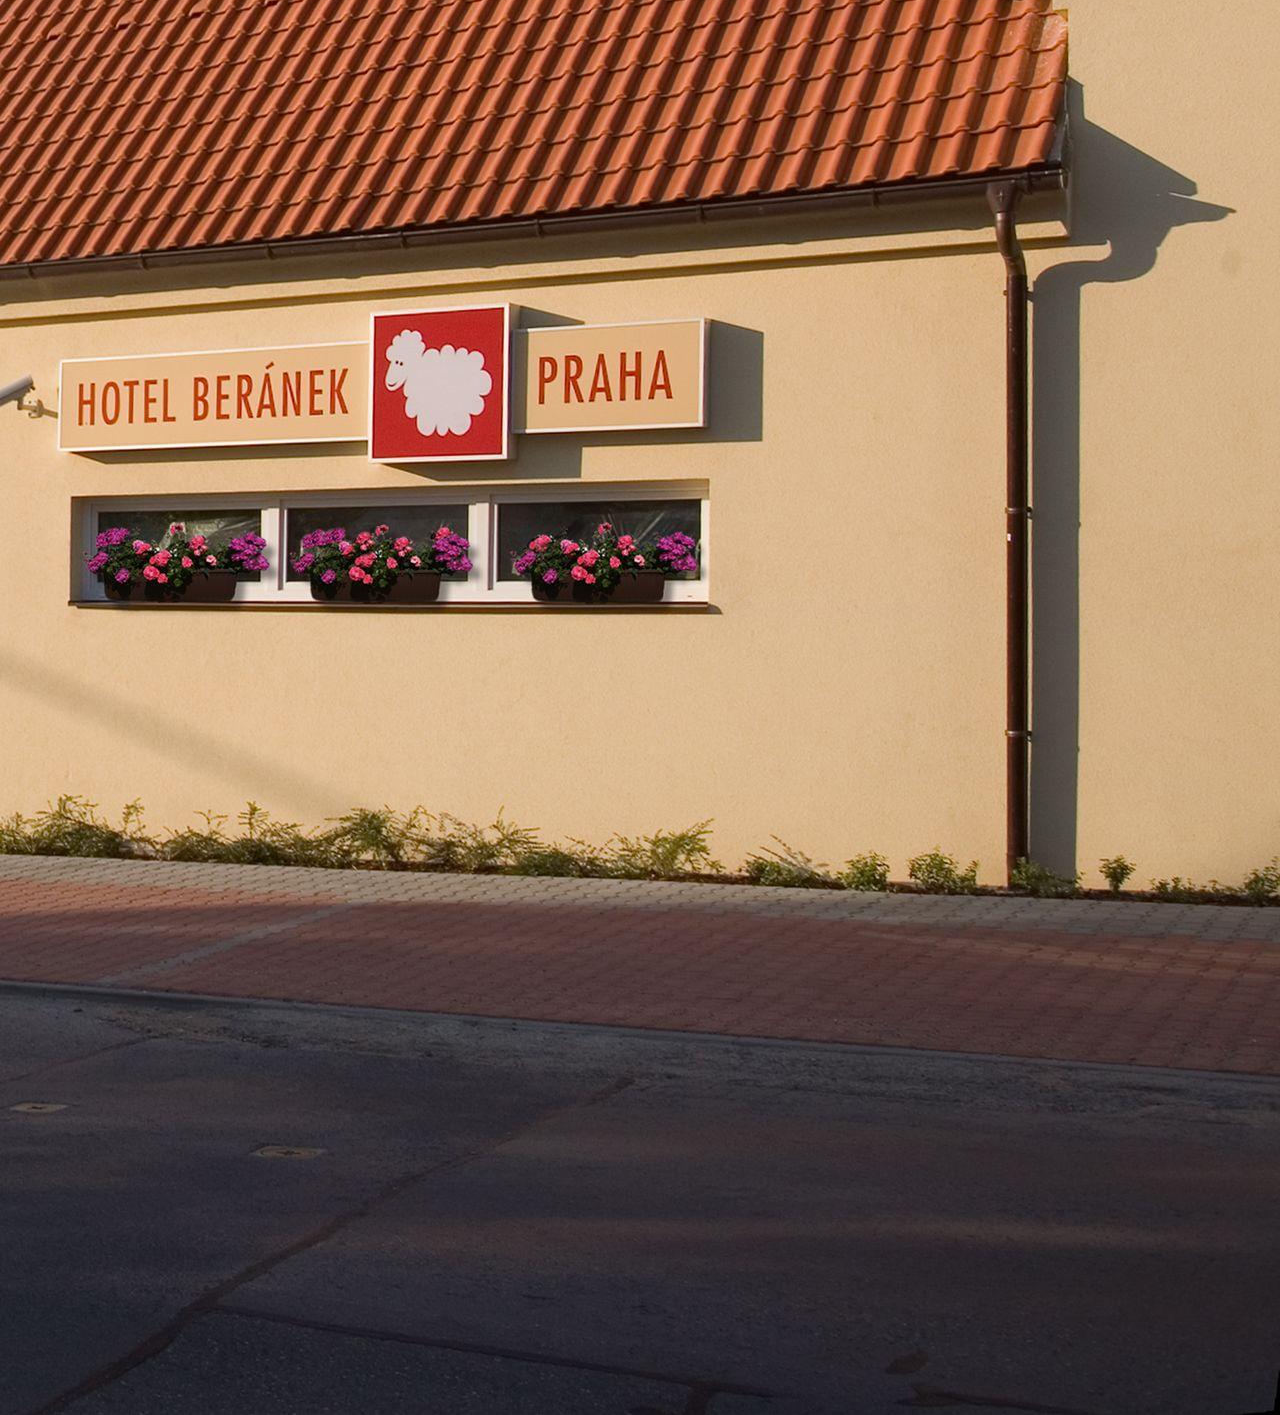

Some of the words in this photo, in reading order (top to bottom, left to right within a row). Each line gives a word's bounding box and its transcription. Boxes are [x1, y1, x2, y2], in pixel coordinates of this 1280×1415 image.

[78, 379, 176, 426] HOTEL
[193, 362, 349, 421] BERÁNEK
[539, 350, 673, 404] PRAHA
